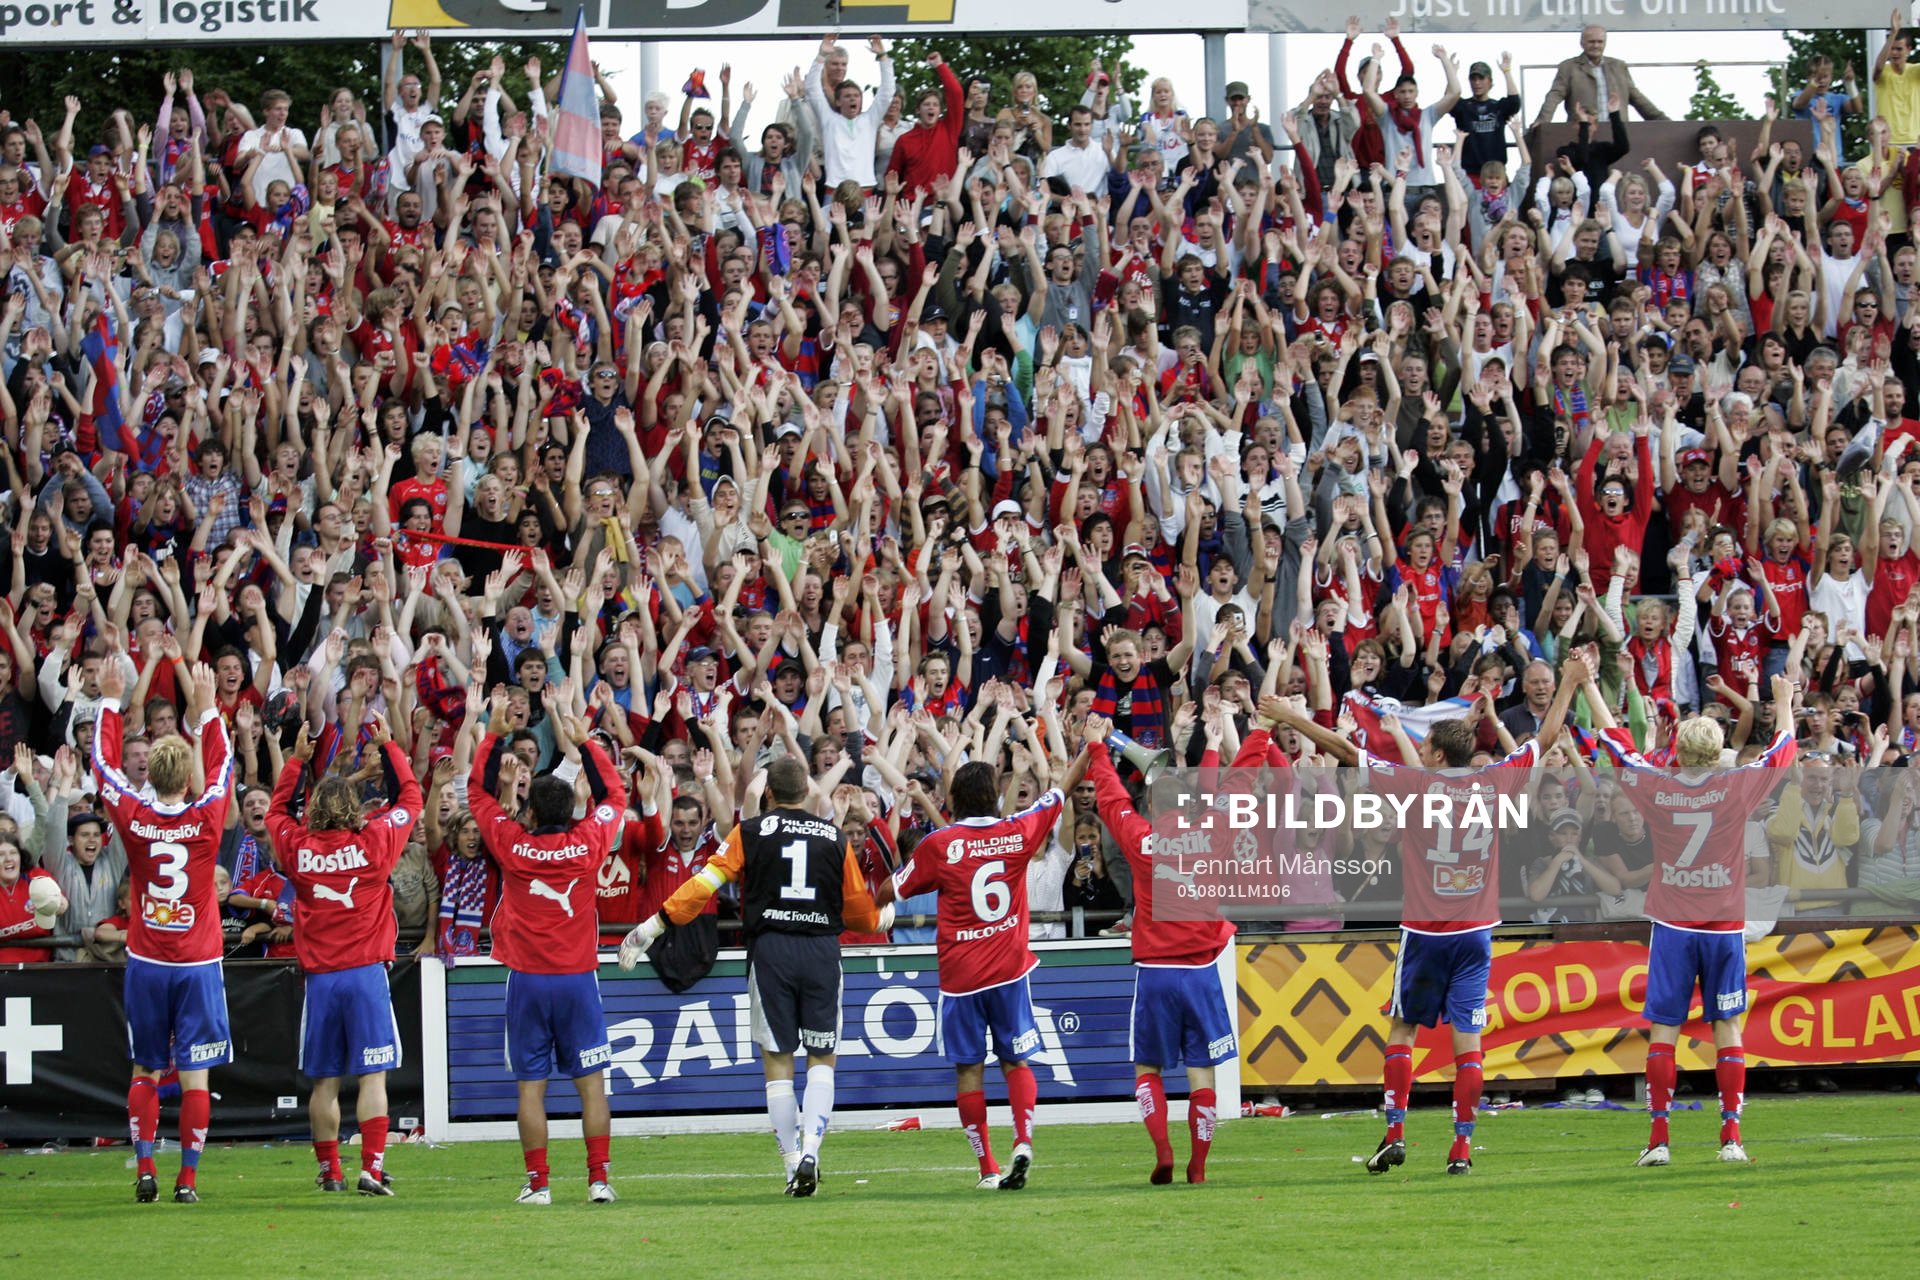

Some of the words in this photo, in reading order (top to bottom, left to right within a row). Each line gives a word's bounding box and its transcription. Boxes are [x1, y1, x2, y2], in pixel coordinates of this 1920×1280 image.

[159, 0, 319, 32] logistik
[781, 819, 837, 834] HILDING
[782, 825, 837, 842] ANDERS
[1672, 812, 1713, 867] 7
[512, 843, 589, 861] nicorette
[967, 833, 1024, 849] HILDING
[968, 843, 1024, 858] ANDERS
[1141, 829, 1213, 857] Bostik
[147, 841, 189, 901] 3
[297, 844, 369, 873] Bostik
[781, 840, 816, 900] 1
[1661, 862, 1733, 888] Bostik
[971, 860, 1011, 923] 6
